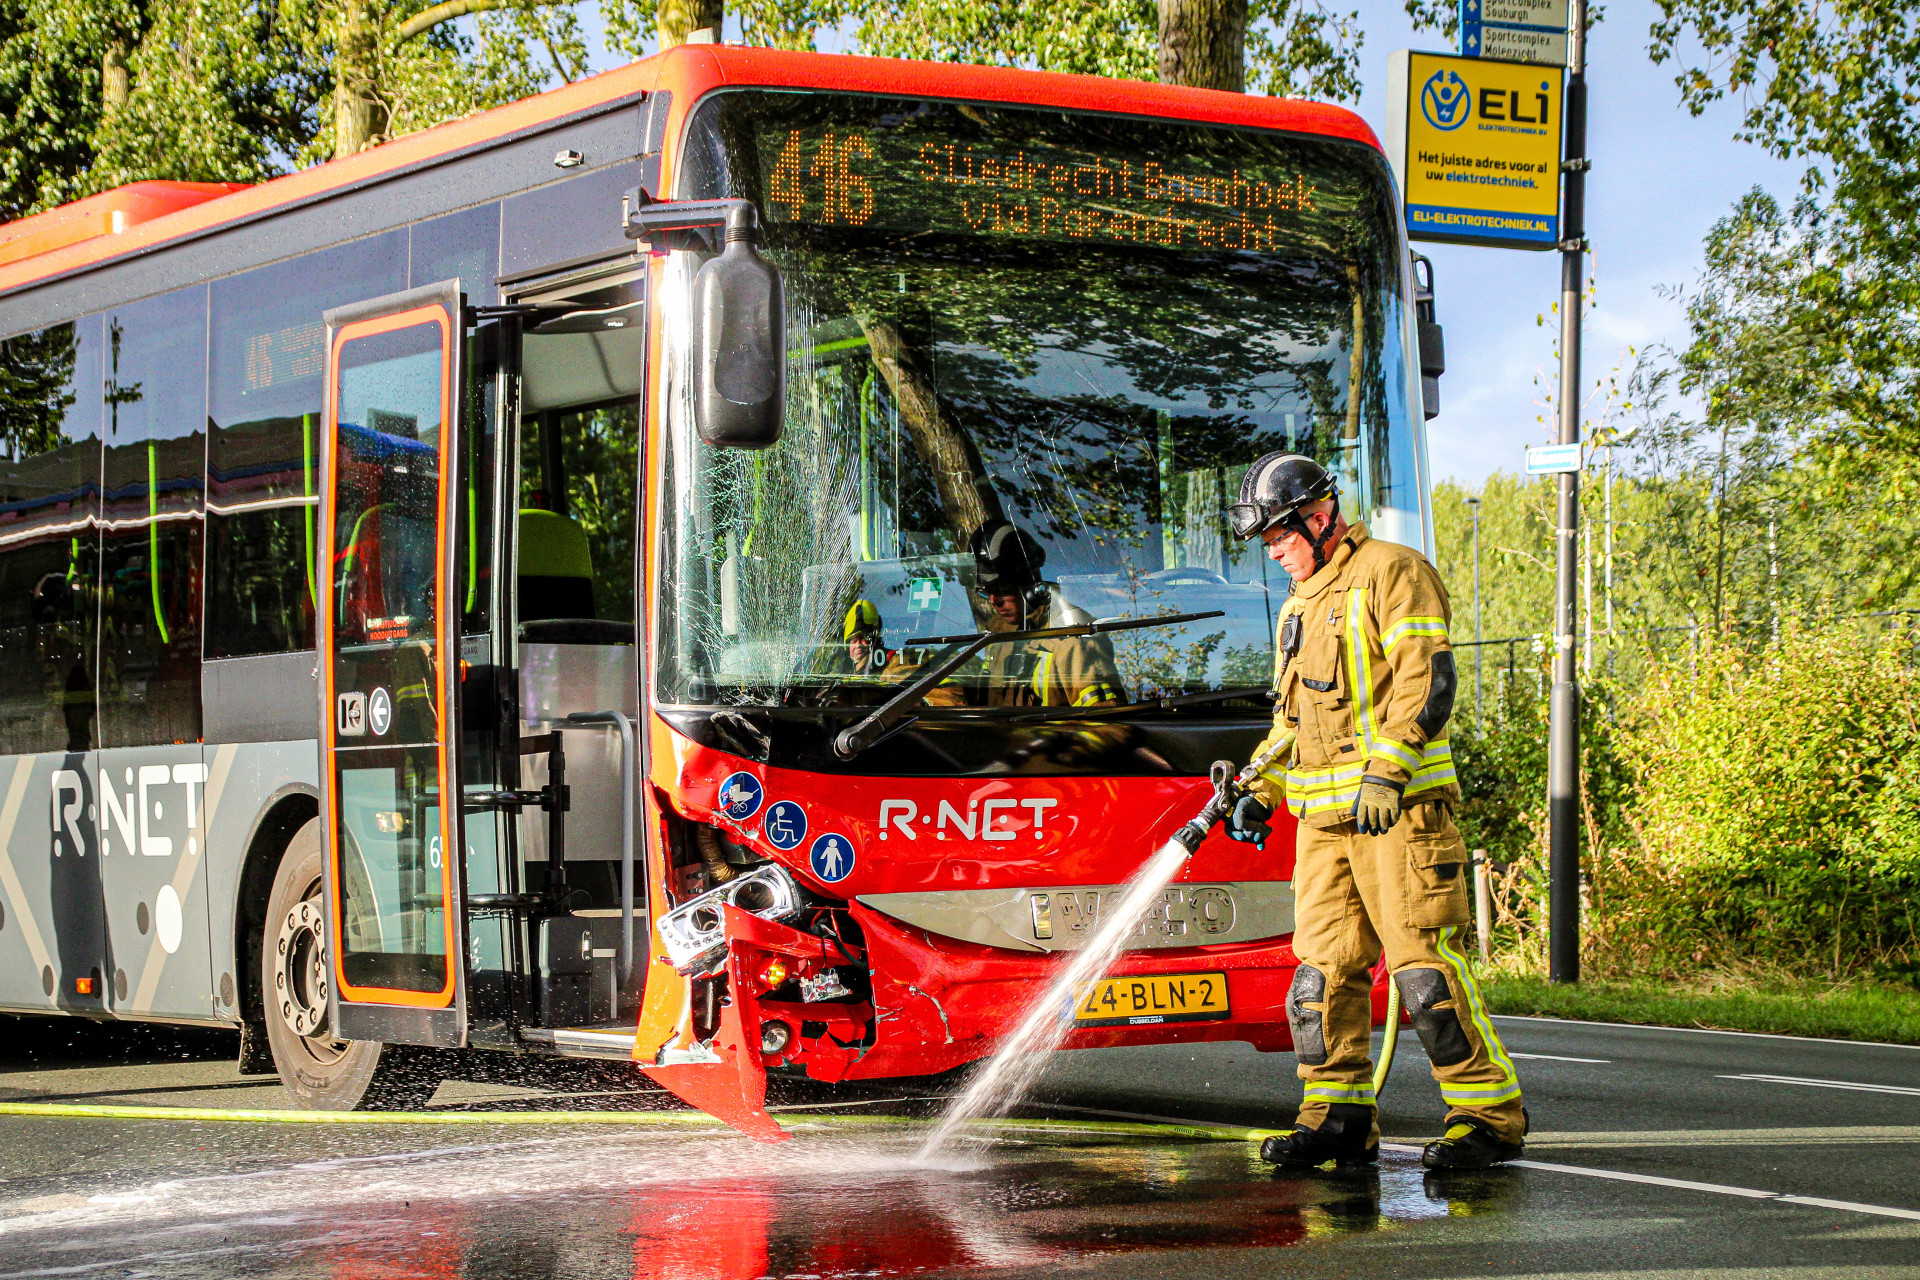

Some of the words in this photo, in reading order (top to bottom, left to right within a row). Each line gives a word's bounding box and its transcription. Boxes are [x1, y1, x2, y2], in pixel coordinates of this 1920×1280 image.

[1485, 5, 1529, 22] Souburgh
[1485, 28, 1551, 47] Sportcomplex
[919, 142, 1134, 200] Sliedrecht
[1418, 150, 1439, 164] Het
[1441, 152, 1473, 167] juiste
[1475, 157, 1507, 170] adres
[1509, 162, 1535, 172] voor
[1537, 162, 1548, 173] al
[770, 129, 874, 226] 416
[1426, 171, 1444, 181] uw
[1445, 171, 1539, 189] elektrotechniek.
[1082, 978, 1216, 1013] 24-BLN-2
